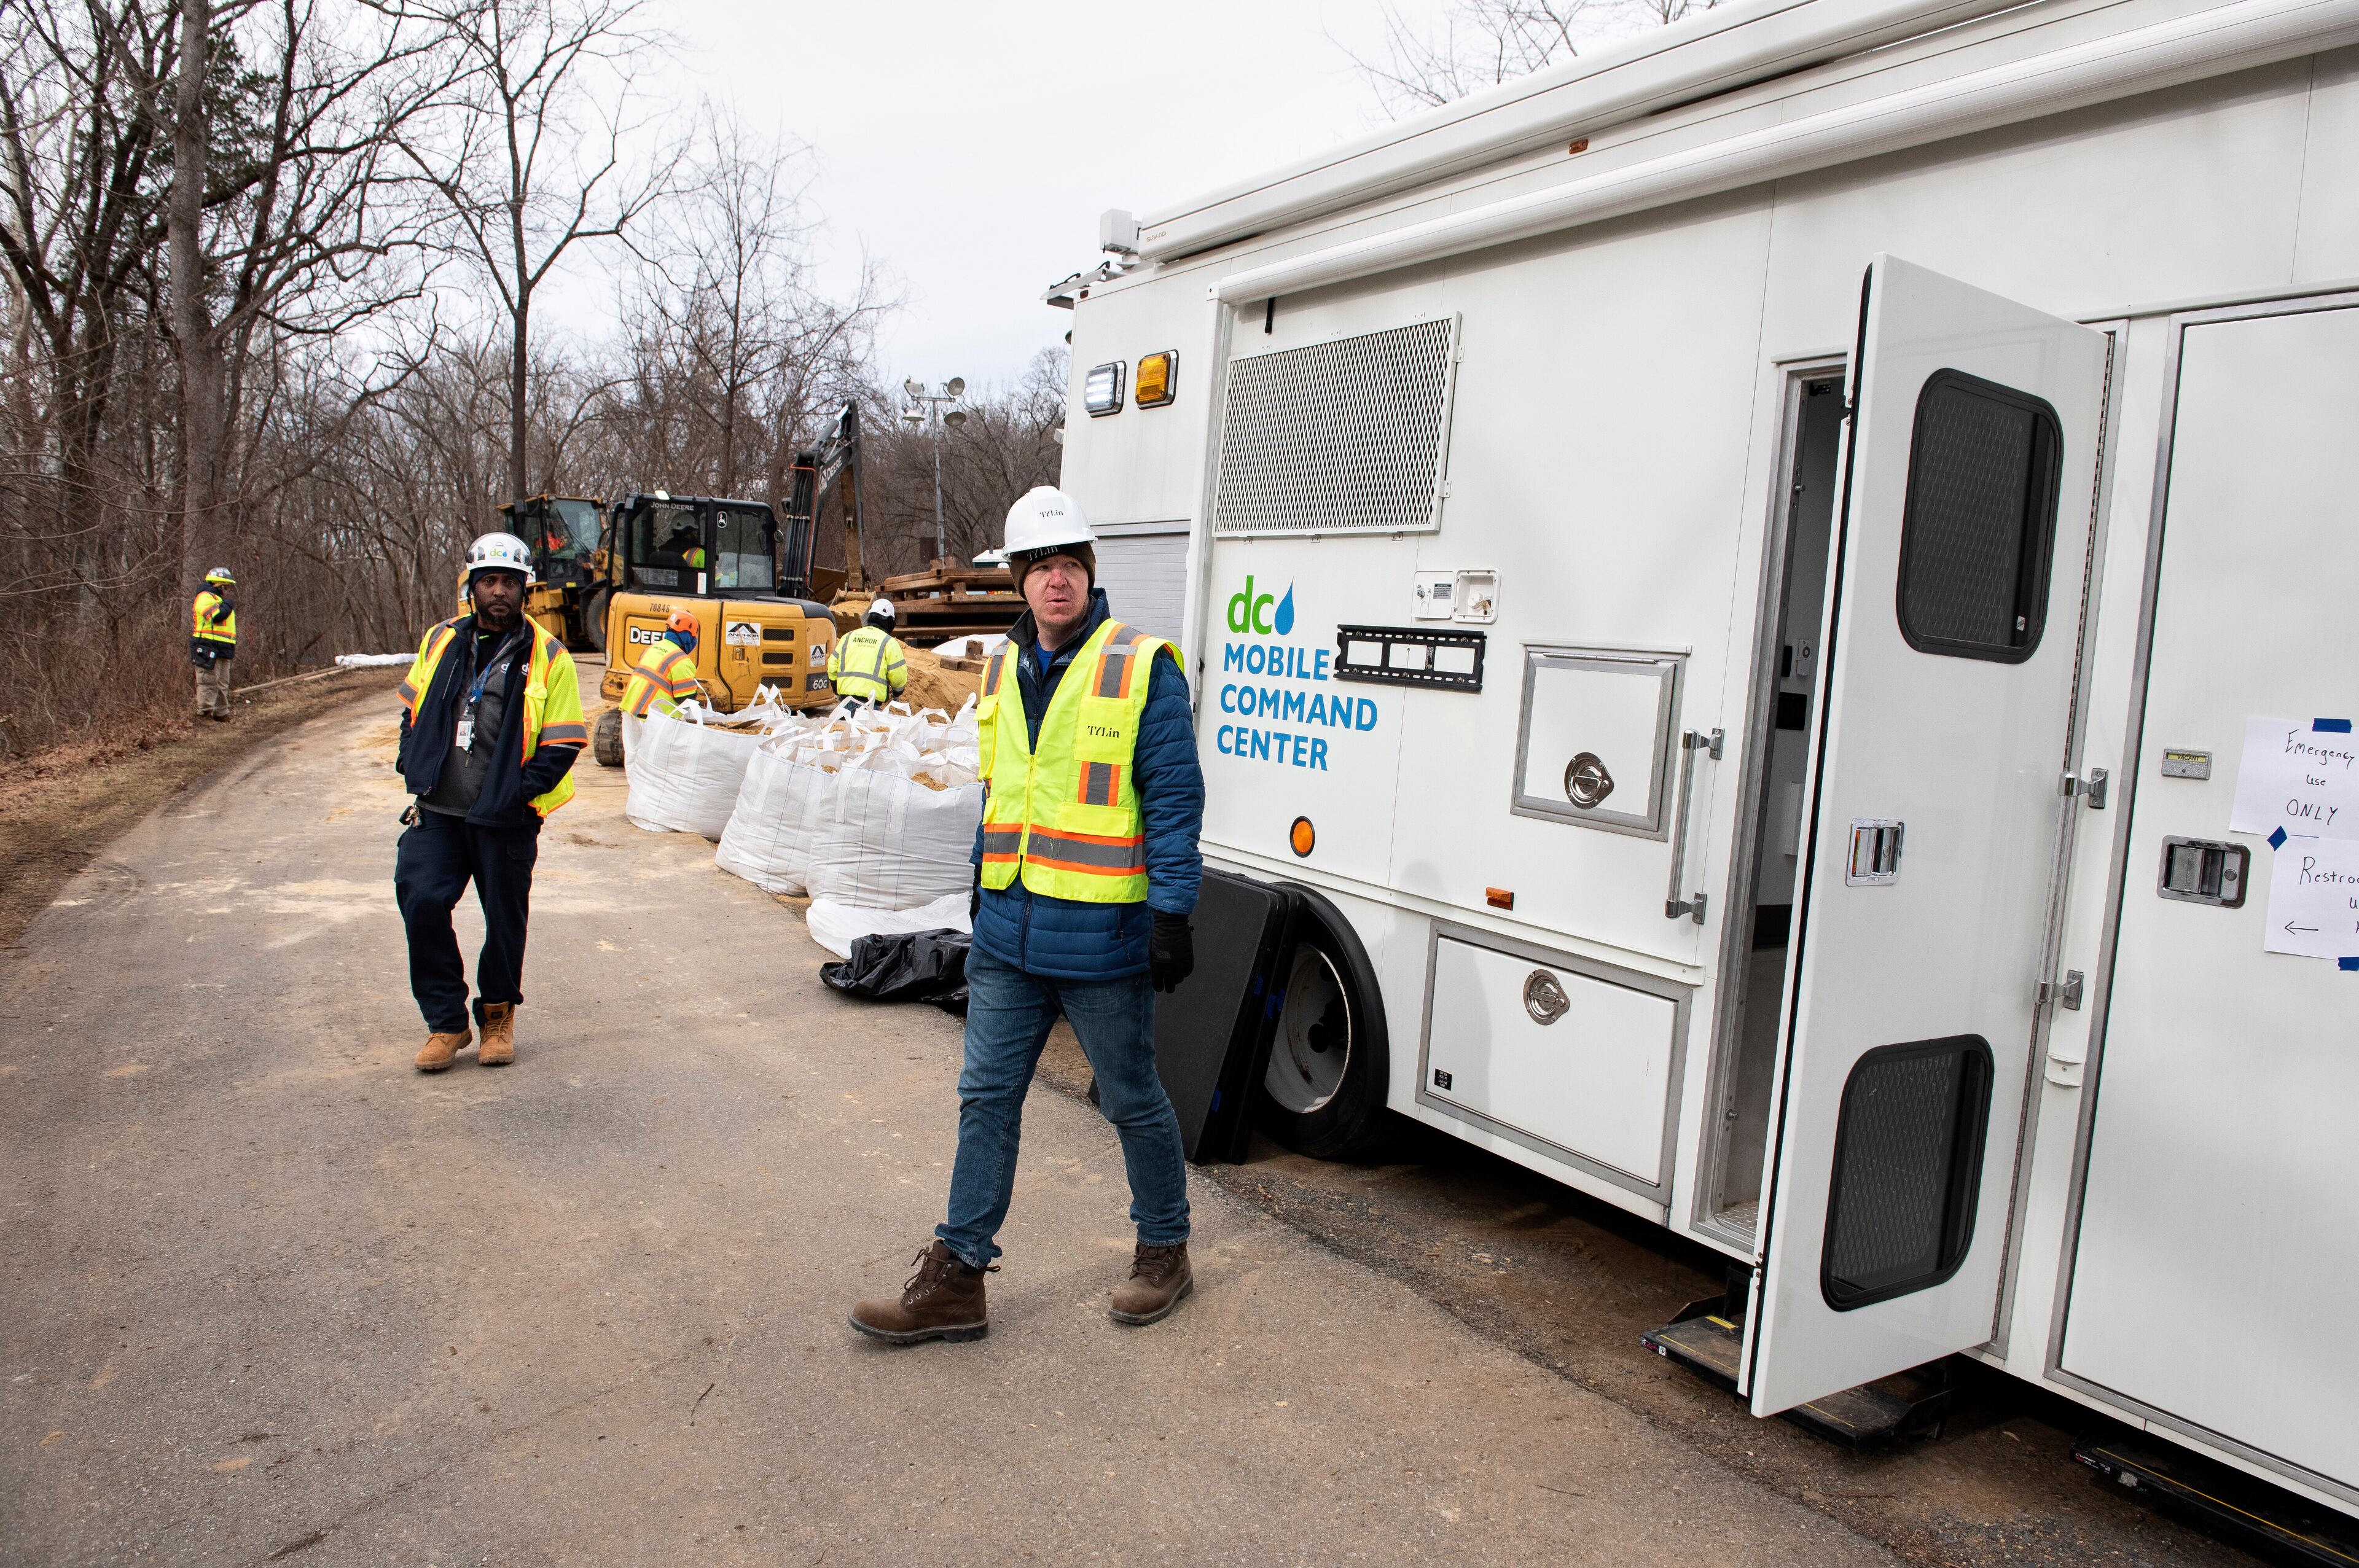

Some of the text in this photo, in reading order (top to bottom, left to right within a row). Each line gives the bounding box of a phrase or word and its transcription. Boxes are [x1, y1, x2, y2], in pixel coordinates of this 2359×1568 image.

[826, 456, 842, 482] DEERE
[1039, 509, 1064, 518] TYLin
[1027, 545, 1058, 561] TYLin
[1227, 575, 1274, 635] dc
[630, 626, 666, 646] DEE
[853, 636, 878, 645] ANCHOR
[1224, 642, 1330, 681] MOBILE
[813, 678, 828, 690] 60G
[1220, 684, 1378, 731] COMMAND
[1087, 725, 1119, 738] TYLin
[1216, 725, 1328, 771] CENTER
[2285, 728, 2355, 770] Emergency
[2287, 798, 2339, 826] ONLY
